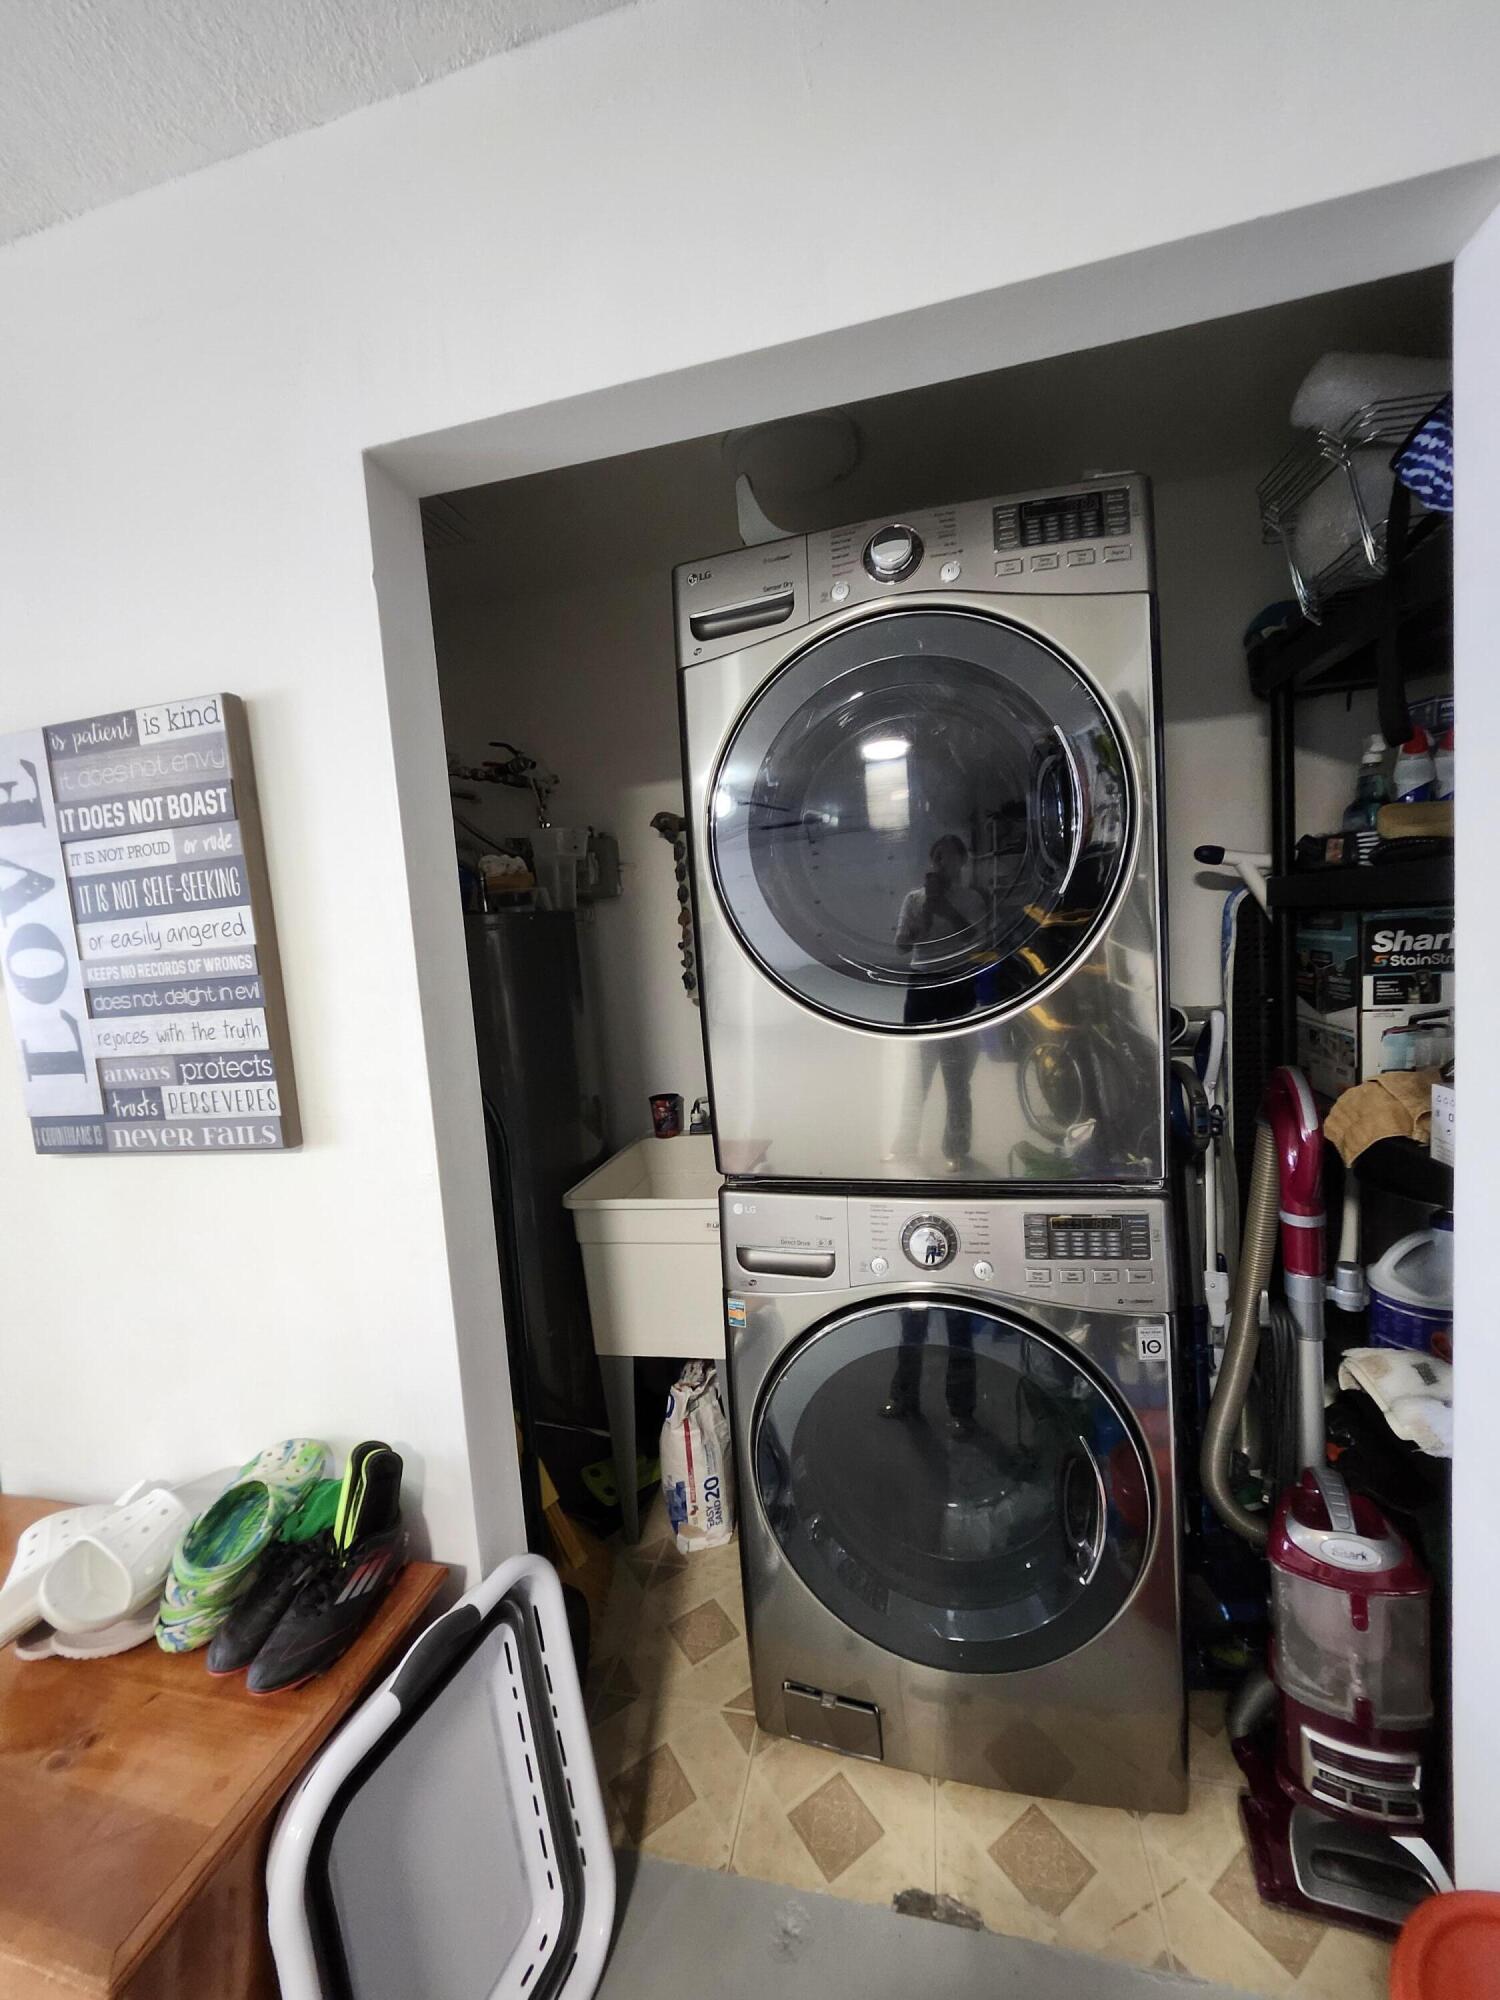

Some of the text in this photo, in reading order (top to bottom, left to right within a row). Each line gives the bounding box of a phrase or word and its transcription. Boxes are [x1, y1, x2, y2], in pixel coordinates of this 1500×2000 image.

[699, 571, 712, 580] LG
[143, 699, 222, 736] is kind
[51, 716, 133, 753] is patient
[79, 762, 132, 788] does
[132, 757, 171, 778] not
[171, 746, 226, 773] envy
[59, 788, 228, 833] IT DOES NOT BOAST
[70, 841, 171, 867] IT IS NOT PROUD
[183, 831, 234, 854] or rude
[79, 866, 242, 914] IT IS NOT SELF-SEEKING
[88, 912, 247, 951] or easily angered
[87, 953, 254, 982] KEEPS NO RECORDS OF WRONGS
[93, 993, 132, 1011] does
[133, 990, 162, 1008] not
[218, 985, 234, 1001] in
[235, 982, 261, 1000] evil
[97, 1018, 263, 1051] rejoices with the truth
[179, 1054, 274, 1086] protects
[112, 1088, 278, 1118] trusts PERSEVERES
[745, 1205, 757, 1214] LG
[1141, 1339, 1162, 1355] 10
[703, 1475, 720, 1502] 20
[706, 1505, 716, 1532] EASY
[714, 1499, 724, 1527] SAND
